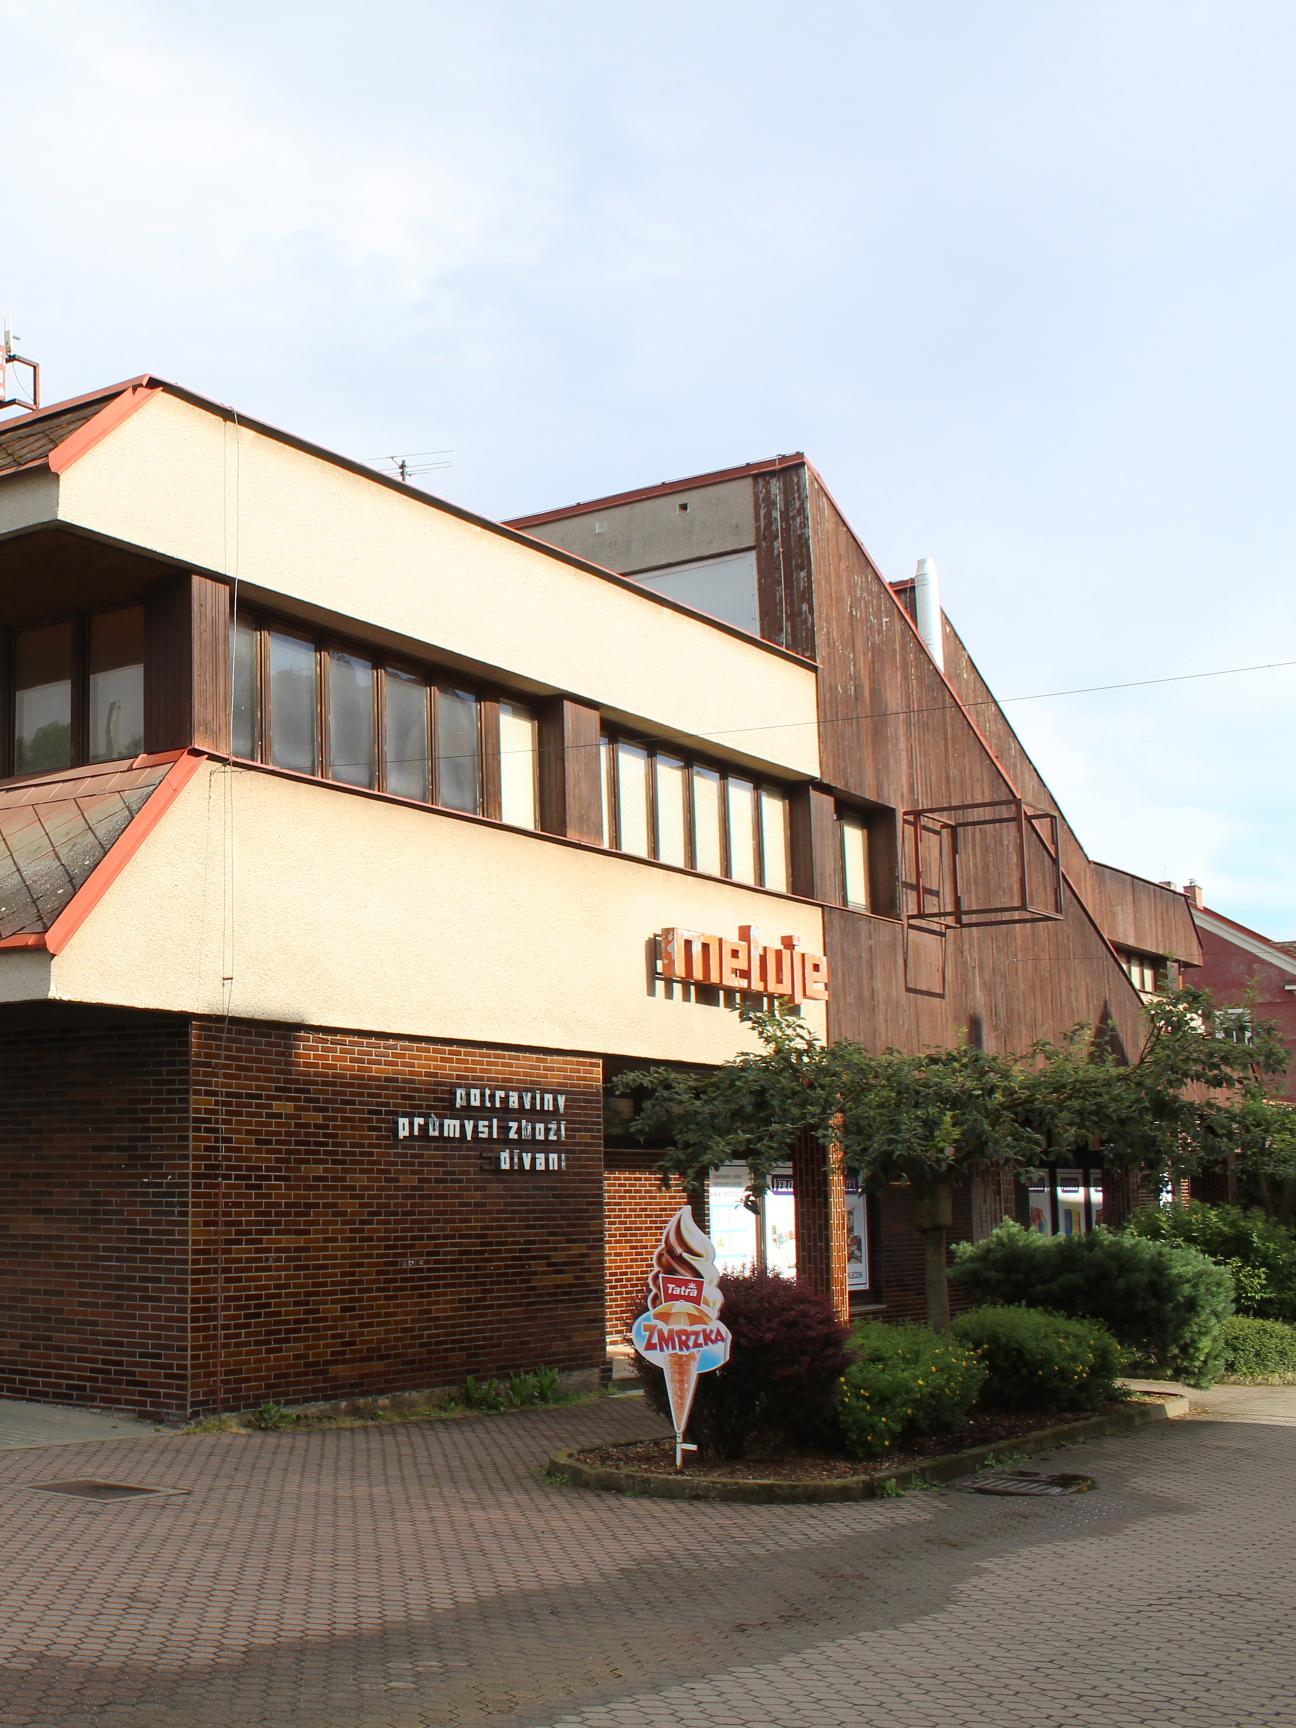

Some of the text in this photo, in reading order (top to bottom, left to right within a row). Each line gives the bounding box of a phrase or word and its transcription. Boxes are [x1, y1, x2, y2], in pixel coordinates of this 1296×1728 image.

[661, 924, 829, 1005] metuje
[455, 1087, 566, 1114] potraviny
[666, 1282, 698, 1298] Tatra
[642, 1323, 726, 1353] ZMRZKA
